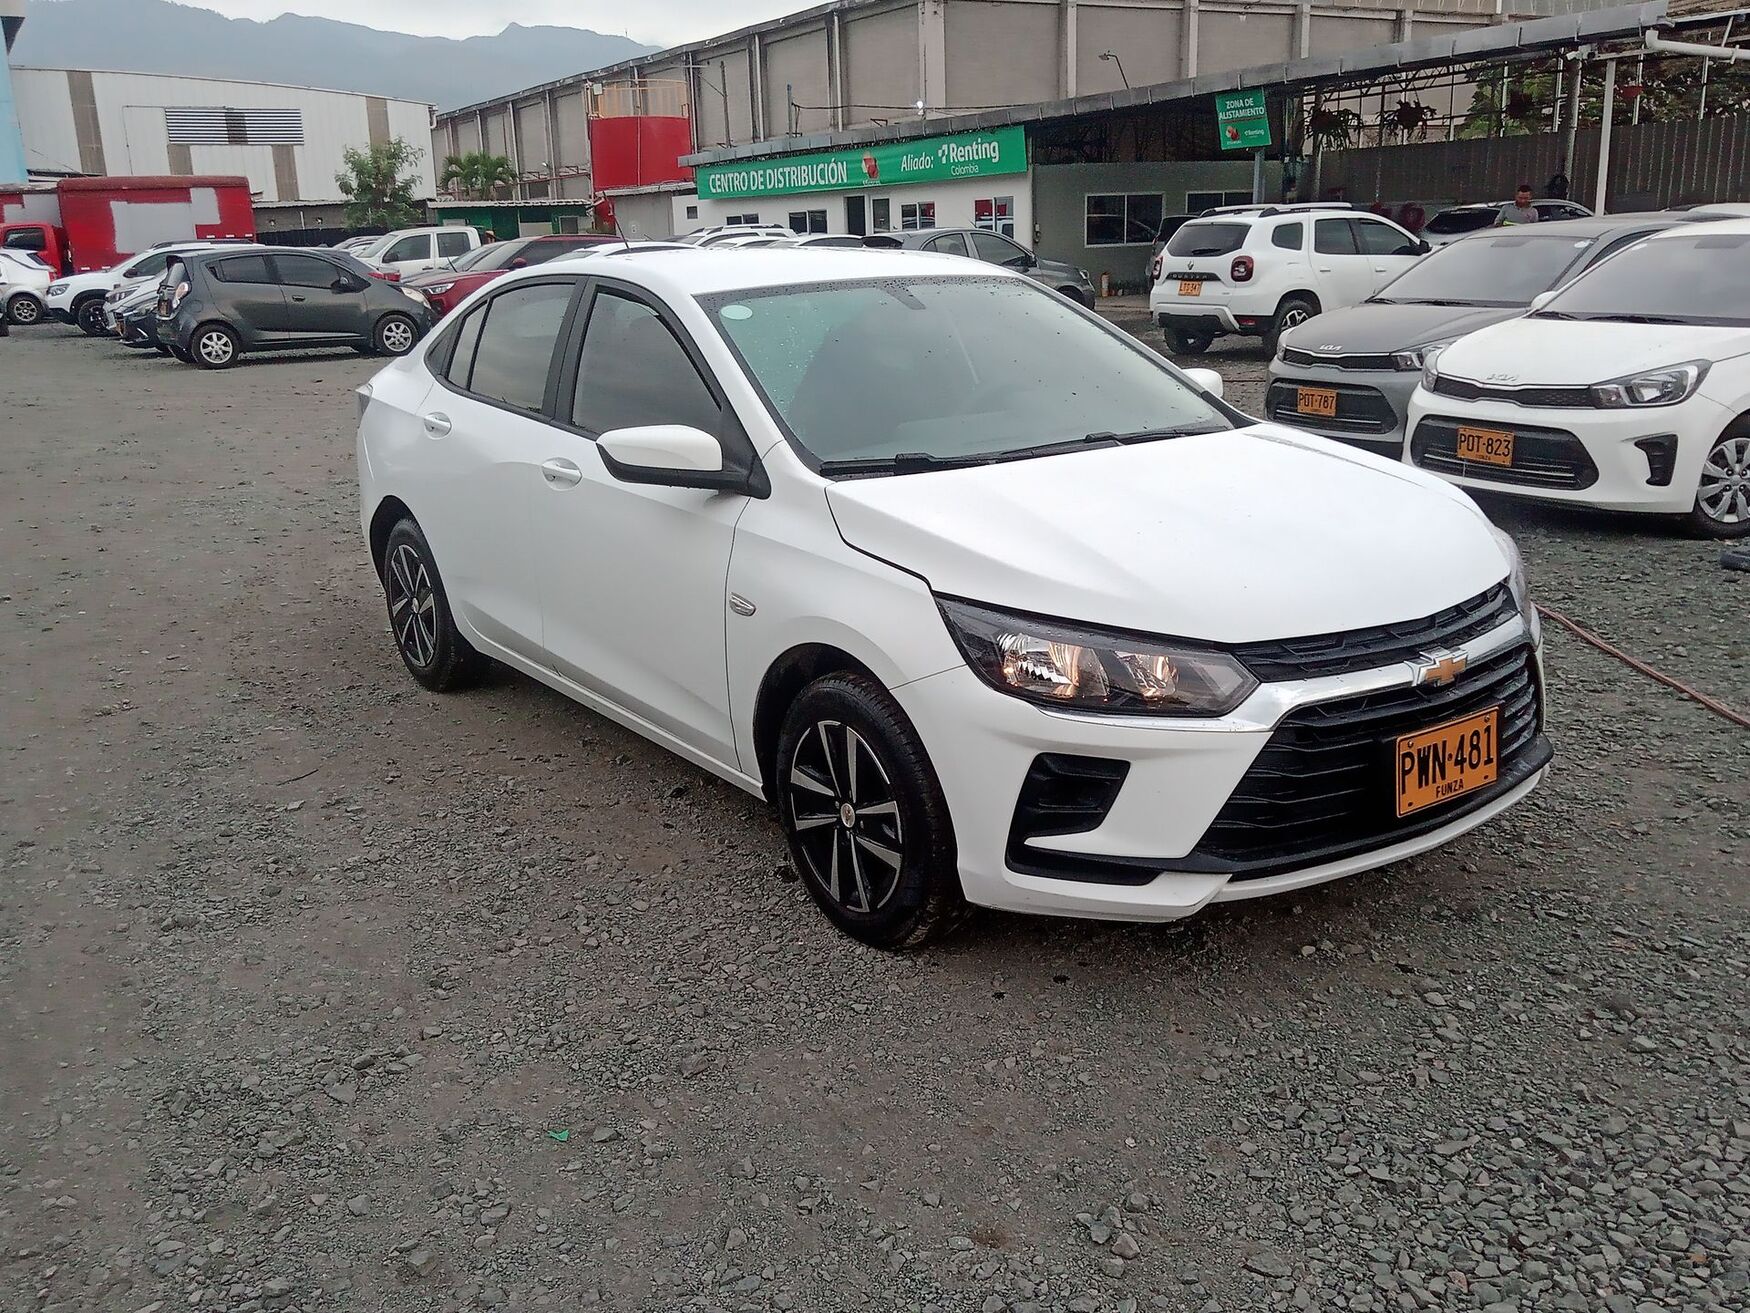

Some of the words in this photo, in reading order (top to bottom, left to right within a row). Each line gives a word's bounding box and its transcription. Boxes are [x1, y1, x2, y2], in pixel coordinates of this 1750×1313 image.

[1225, 99, 1245, 109] ZONA
[1244, 97, 1254, 106] DE
[1219, 107, 1265, 120] ALISTAMIENTO
[950, 138, 999, 163] Renting
[901, 152, 934, 172] Aliado:
[951, 163, 979, 176] Colombia
[709, 171, 748, 193] CENTRO
[750, 170, 765, 191] DE
[766, 158, 848, 189] DISTRIBUCIÓN
[1435, 778, 1464, 798] FUNZA
